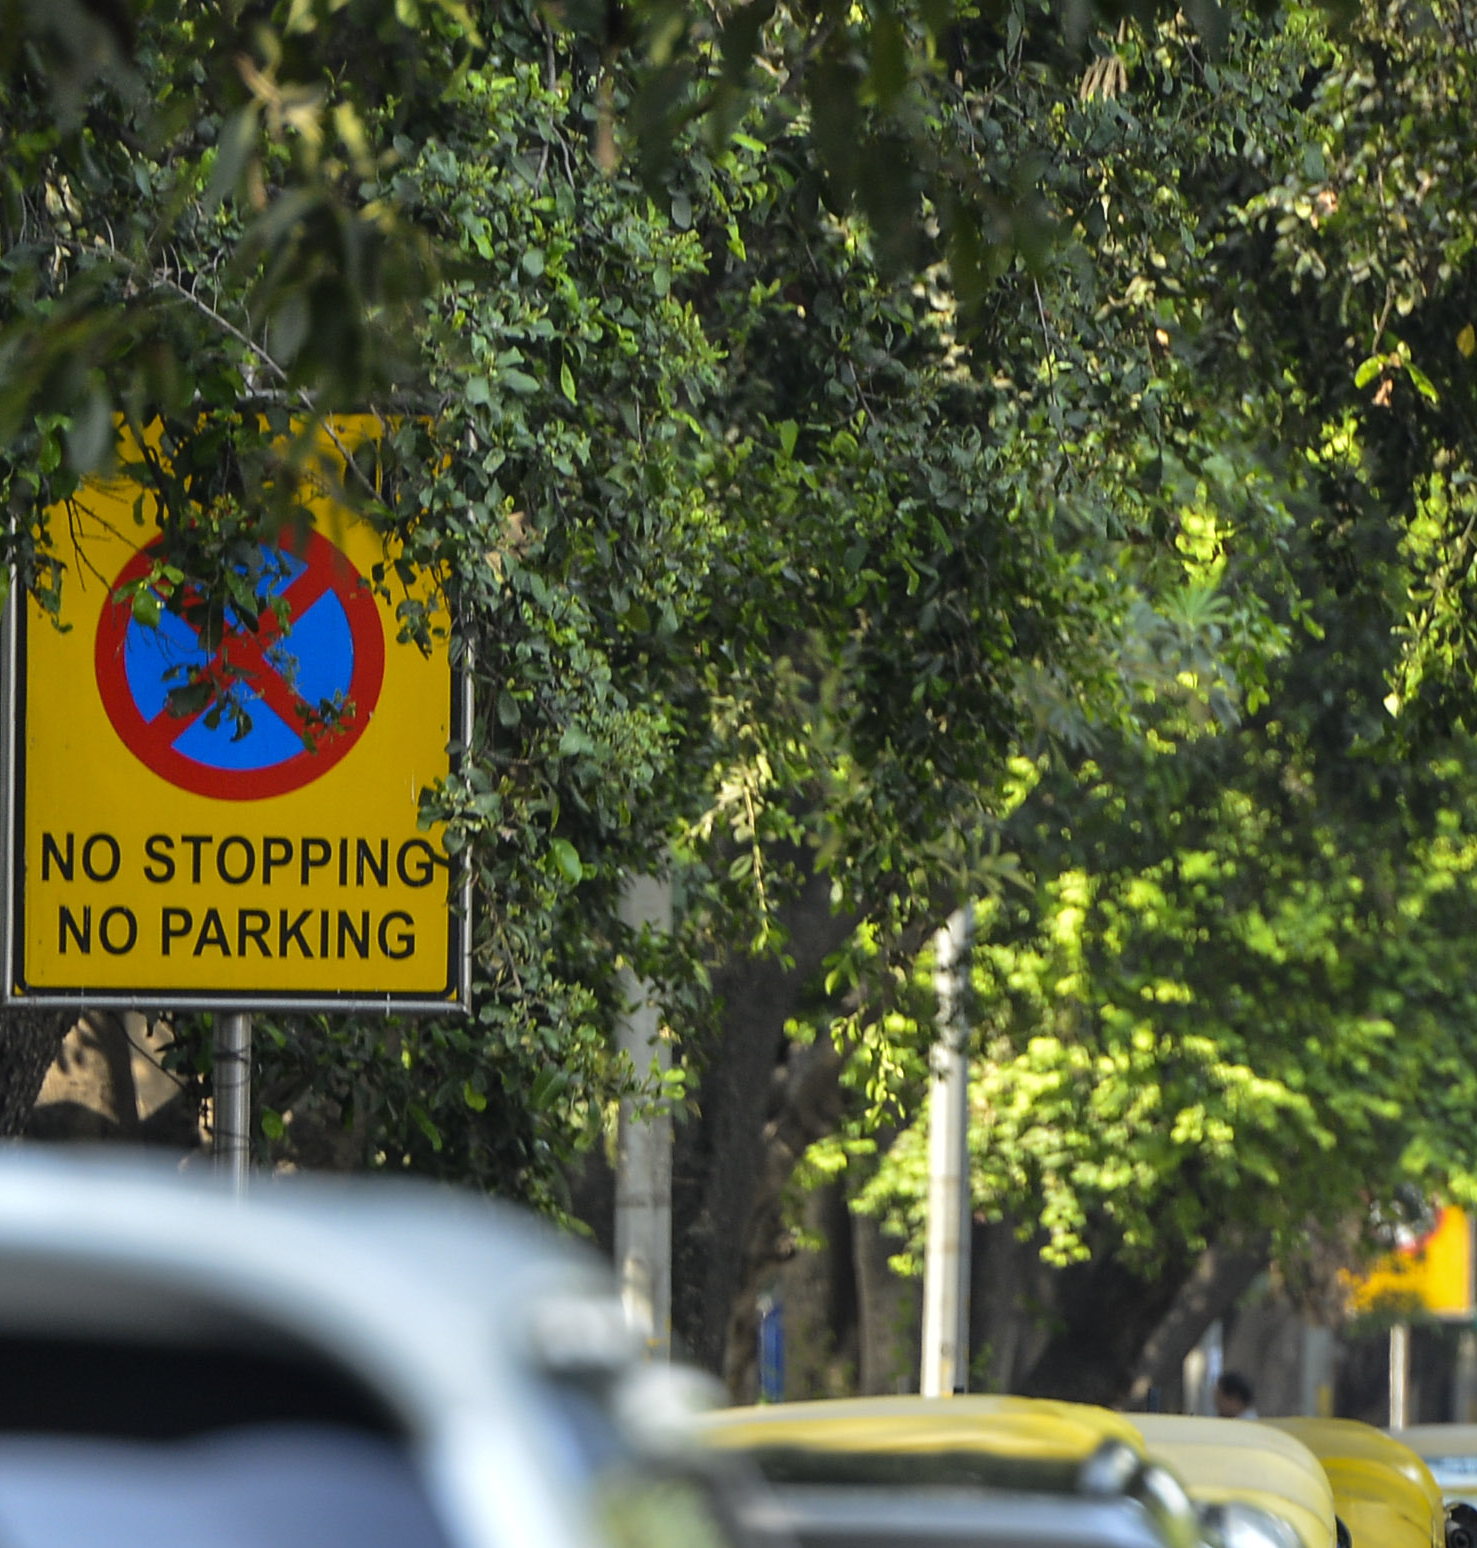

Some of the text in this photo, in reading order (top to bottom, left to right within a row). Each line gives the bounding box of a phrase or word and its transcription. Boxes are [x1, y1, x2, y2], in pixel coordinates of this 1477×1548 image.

[41, 832, 435, 888] NO STOPPING
[57, 905, 417, 960] NO PARKING
